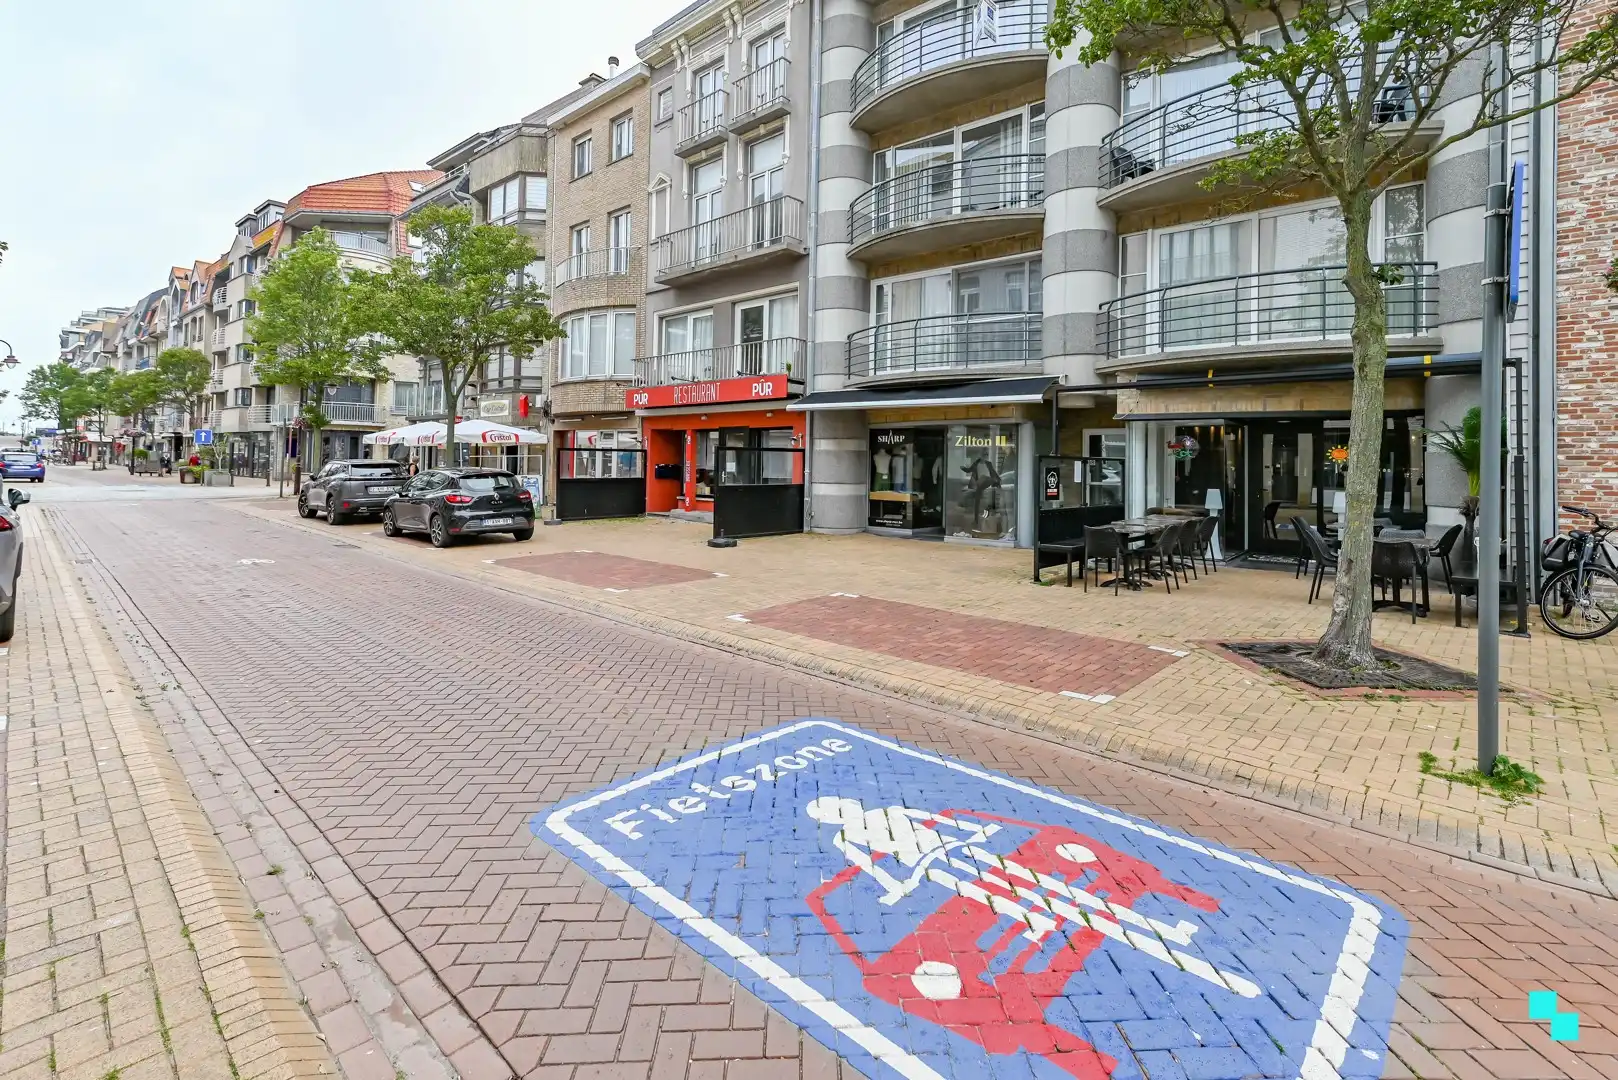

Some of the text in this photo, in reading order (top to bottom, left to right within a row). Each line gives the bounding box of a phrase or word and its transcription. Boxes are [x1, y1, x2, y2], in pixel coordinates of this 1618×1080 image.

[633, 378, 773, 405] PÛR RESTAURANT PÛR
[489, 433, 512, 442] Cristal
[877, 430, 905, 444] SHARP
[954, 435, 992, 447] Zilton
[603, 737, 852, 840] Fietszone
